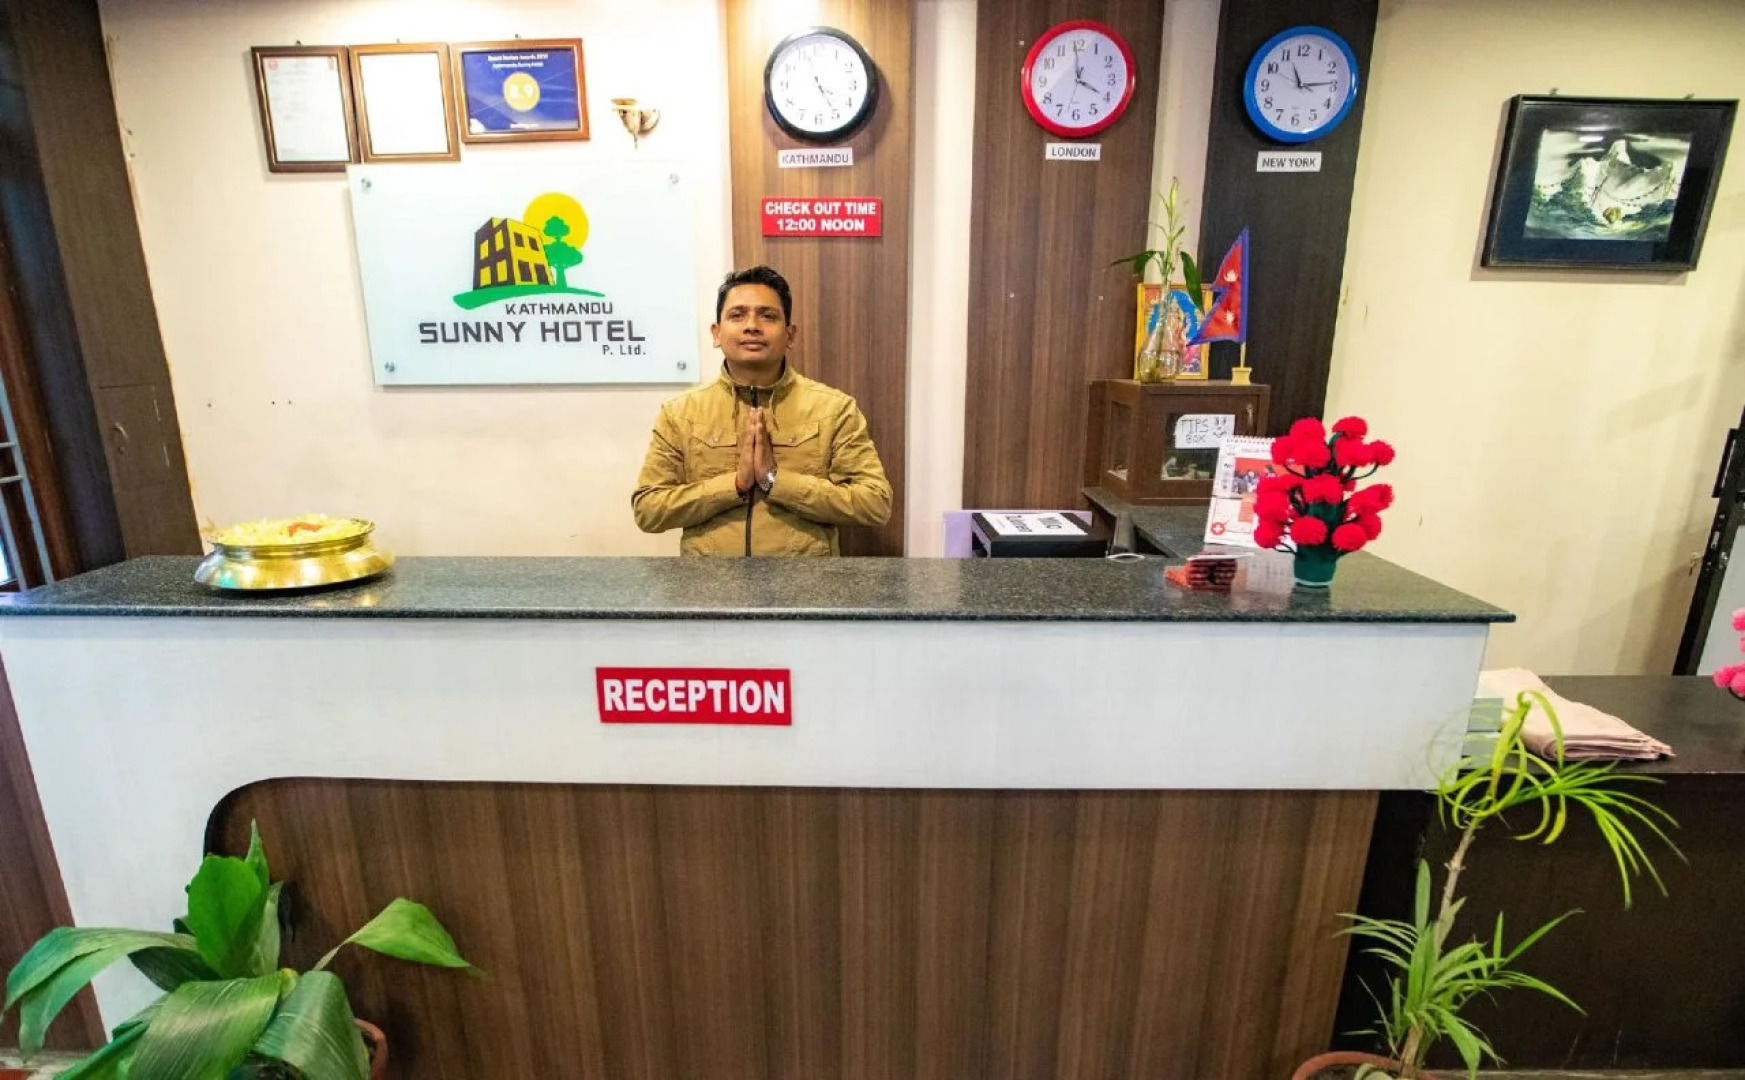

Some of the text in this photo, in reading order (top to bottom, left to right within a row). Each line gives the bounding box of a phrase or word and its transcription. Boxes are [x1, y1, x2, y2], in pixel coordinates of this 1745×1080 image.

[1057, 45, 1065, 56] 11
[1094, 43, 1098, 55] 1
[1282, 49, 1290, 60] 11
[1297, 44, 1310, 57] 12
[1318, 49, 1322, 60] 1
[1044, 57, 1055, 69] 10
[1104, 55, 1113, 68] 2
[1327, 61, 1336, 74] 2
[1268, 62, 1279, 74] 10
[1038, 76, 1047, 88] 9
[1107, 73, 1116, 86] 3
[1260, 80, 1269, 92] 9
[1329, 80, 1337, 92] 3
[1042, 92, 1052, 104] 8
[1103, 91, 1110, 102] 4
[1264, 97, 1273, 109] 8
[1323, 97, 1331, 109] 4
[1056, 104, 1064, 116] 7
[1072, 109, 1080, 121] 6
[1089, 103, 1098, 116] 5
[1276, 109, 1284, 121] 7
[1309, 109, 1317, 121] 5
[1291, 114, 1300, 126] 6
[1051, 146, 1096, 157] LONDON
[782, 153, 849, 164] KATHMANDU
[1261, 157, 1316, 168] NEW YORK
[765, 202, 877, 215] CHECK OUT TIME
[777, 218, 865, 231] 12:00 NOON
[505, 302, 613, 315] KATHMANDU
[418, 320, 646, 344] SUNNY HOTEL
[602, 344, 646, 355] P. Ltd.
[1181, 419, 1208, 434] TIPS
[1186, 435, 1206, 443] BOX
[602, 679, 785, 714] RECEPTION
